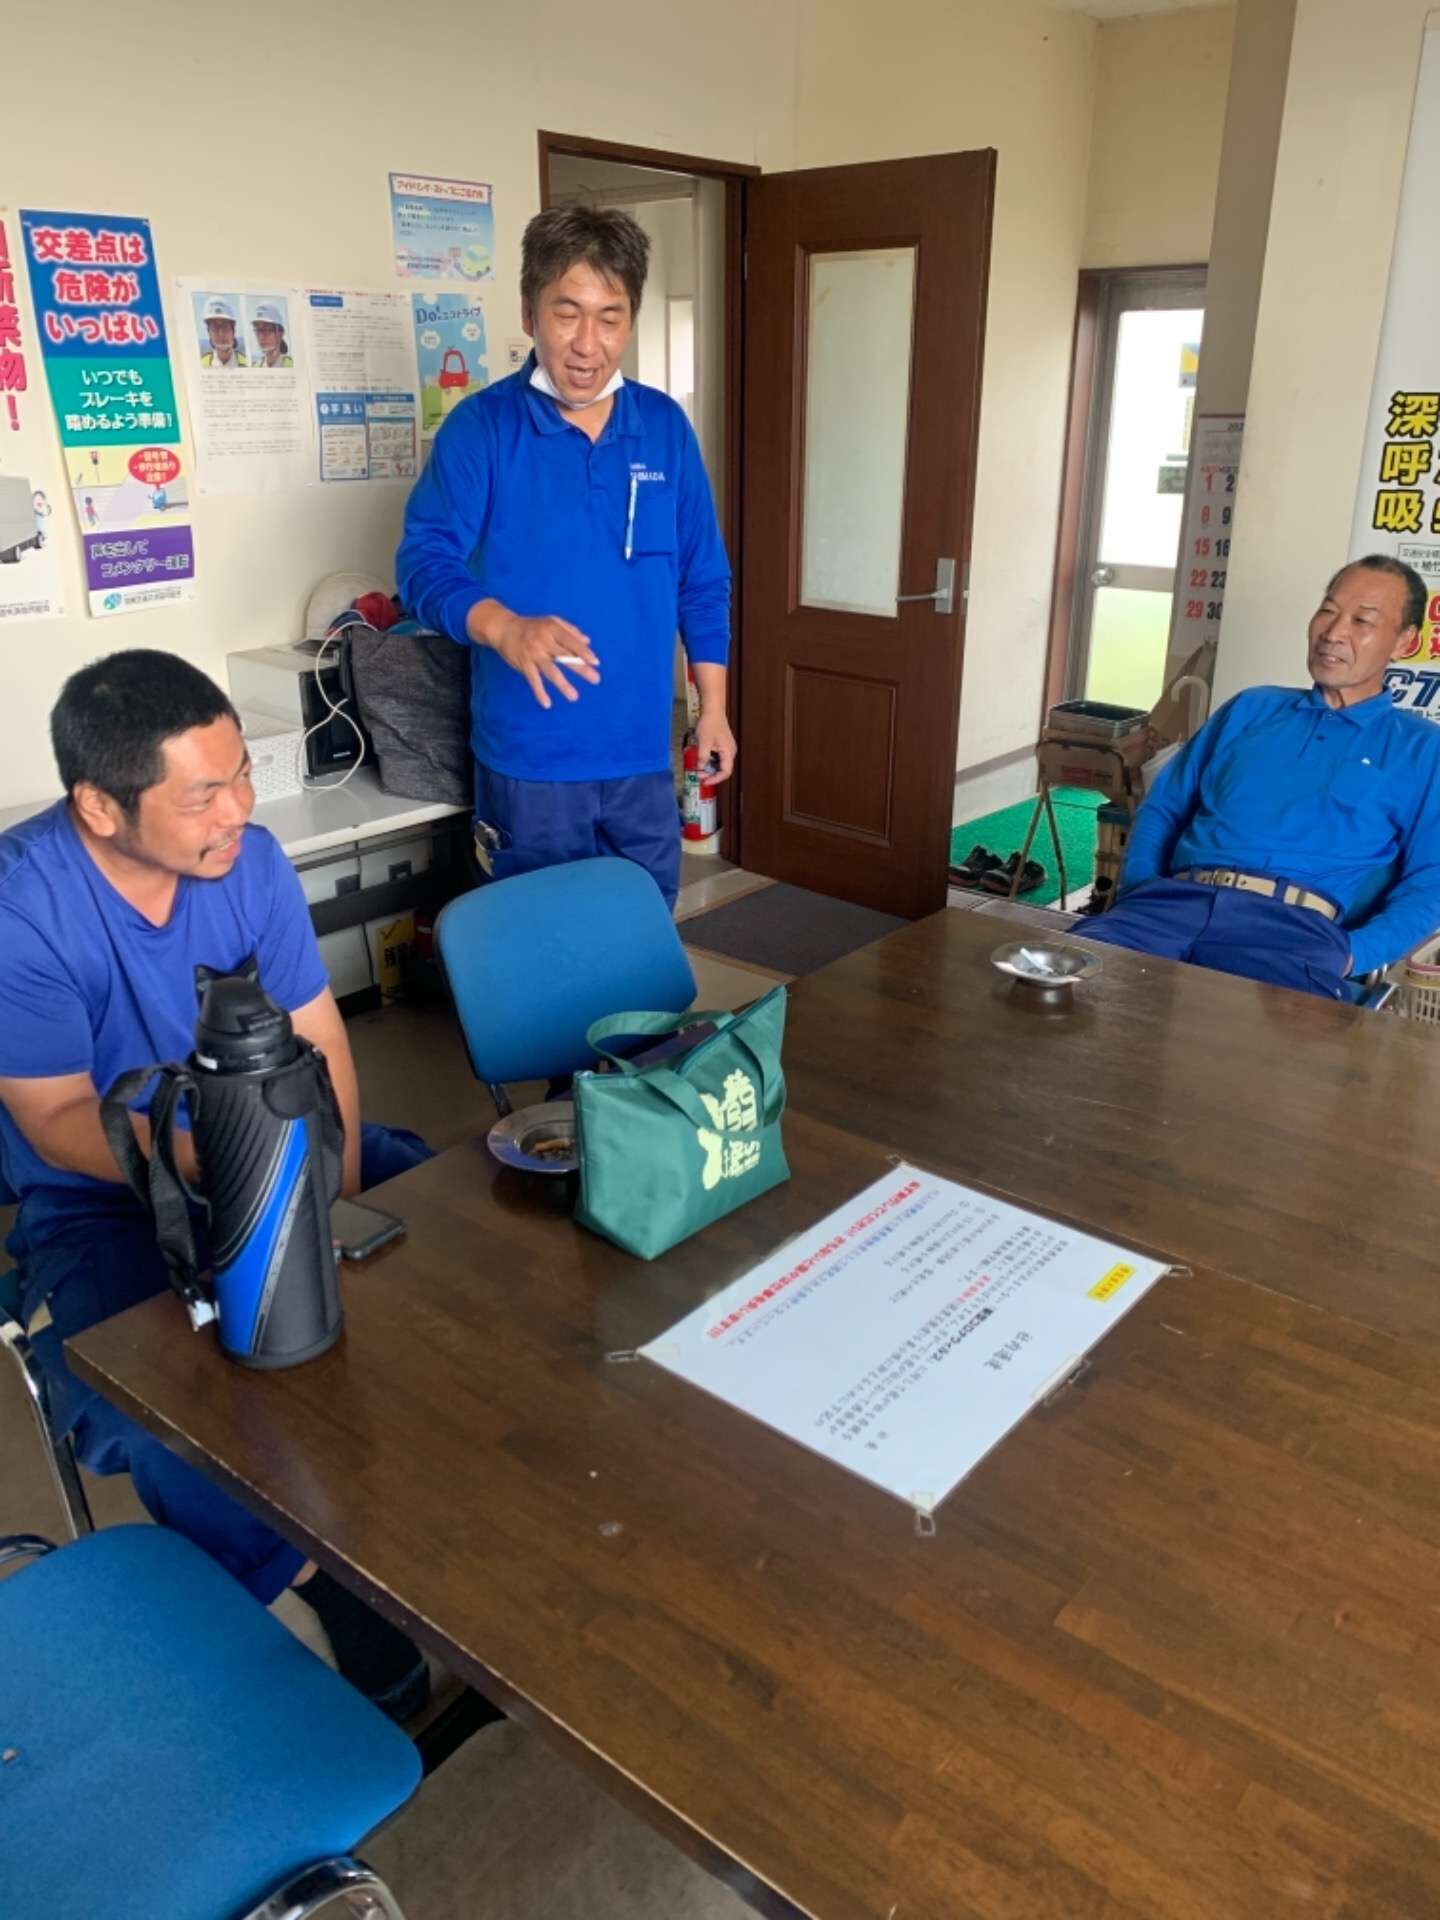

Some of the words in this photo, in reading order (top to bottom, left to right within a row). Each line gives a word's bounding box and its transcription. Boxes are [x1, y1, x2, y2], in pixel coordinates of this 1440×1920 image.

[32, 227, 147, 266] 交差点は
[53, 269, 140, 304] 危険が
[45, 311, 158, 343] いっぱい
[81, 369, 143, 386] いつでも
[79, 391, 153, 408] ブレーキを
[1373, 391, 1440, 532] 深呼吸
[1205, 474, 1213, 491] 1
[1226, 474, 1235, 492] 2
[1201, 506, 1210, 524] 8
[1222, 507, 1231, 524] 9
[1194, 538, 1210, 556] 15
[1215, 539, 1229, 557] 16
[1190, 569, 1207, 587] 22
[1211, 571, 1226, 588] 23
[1185, 600, 1203, 619] 29
[1207, 602, 1222, 619] 30
